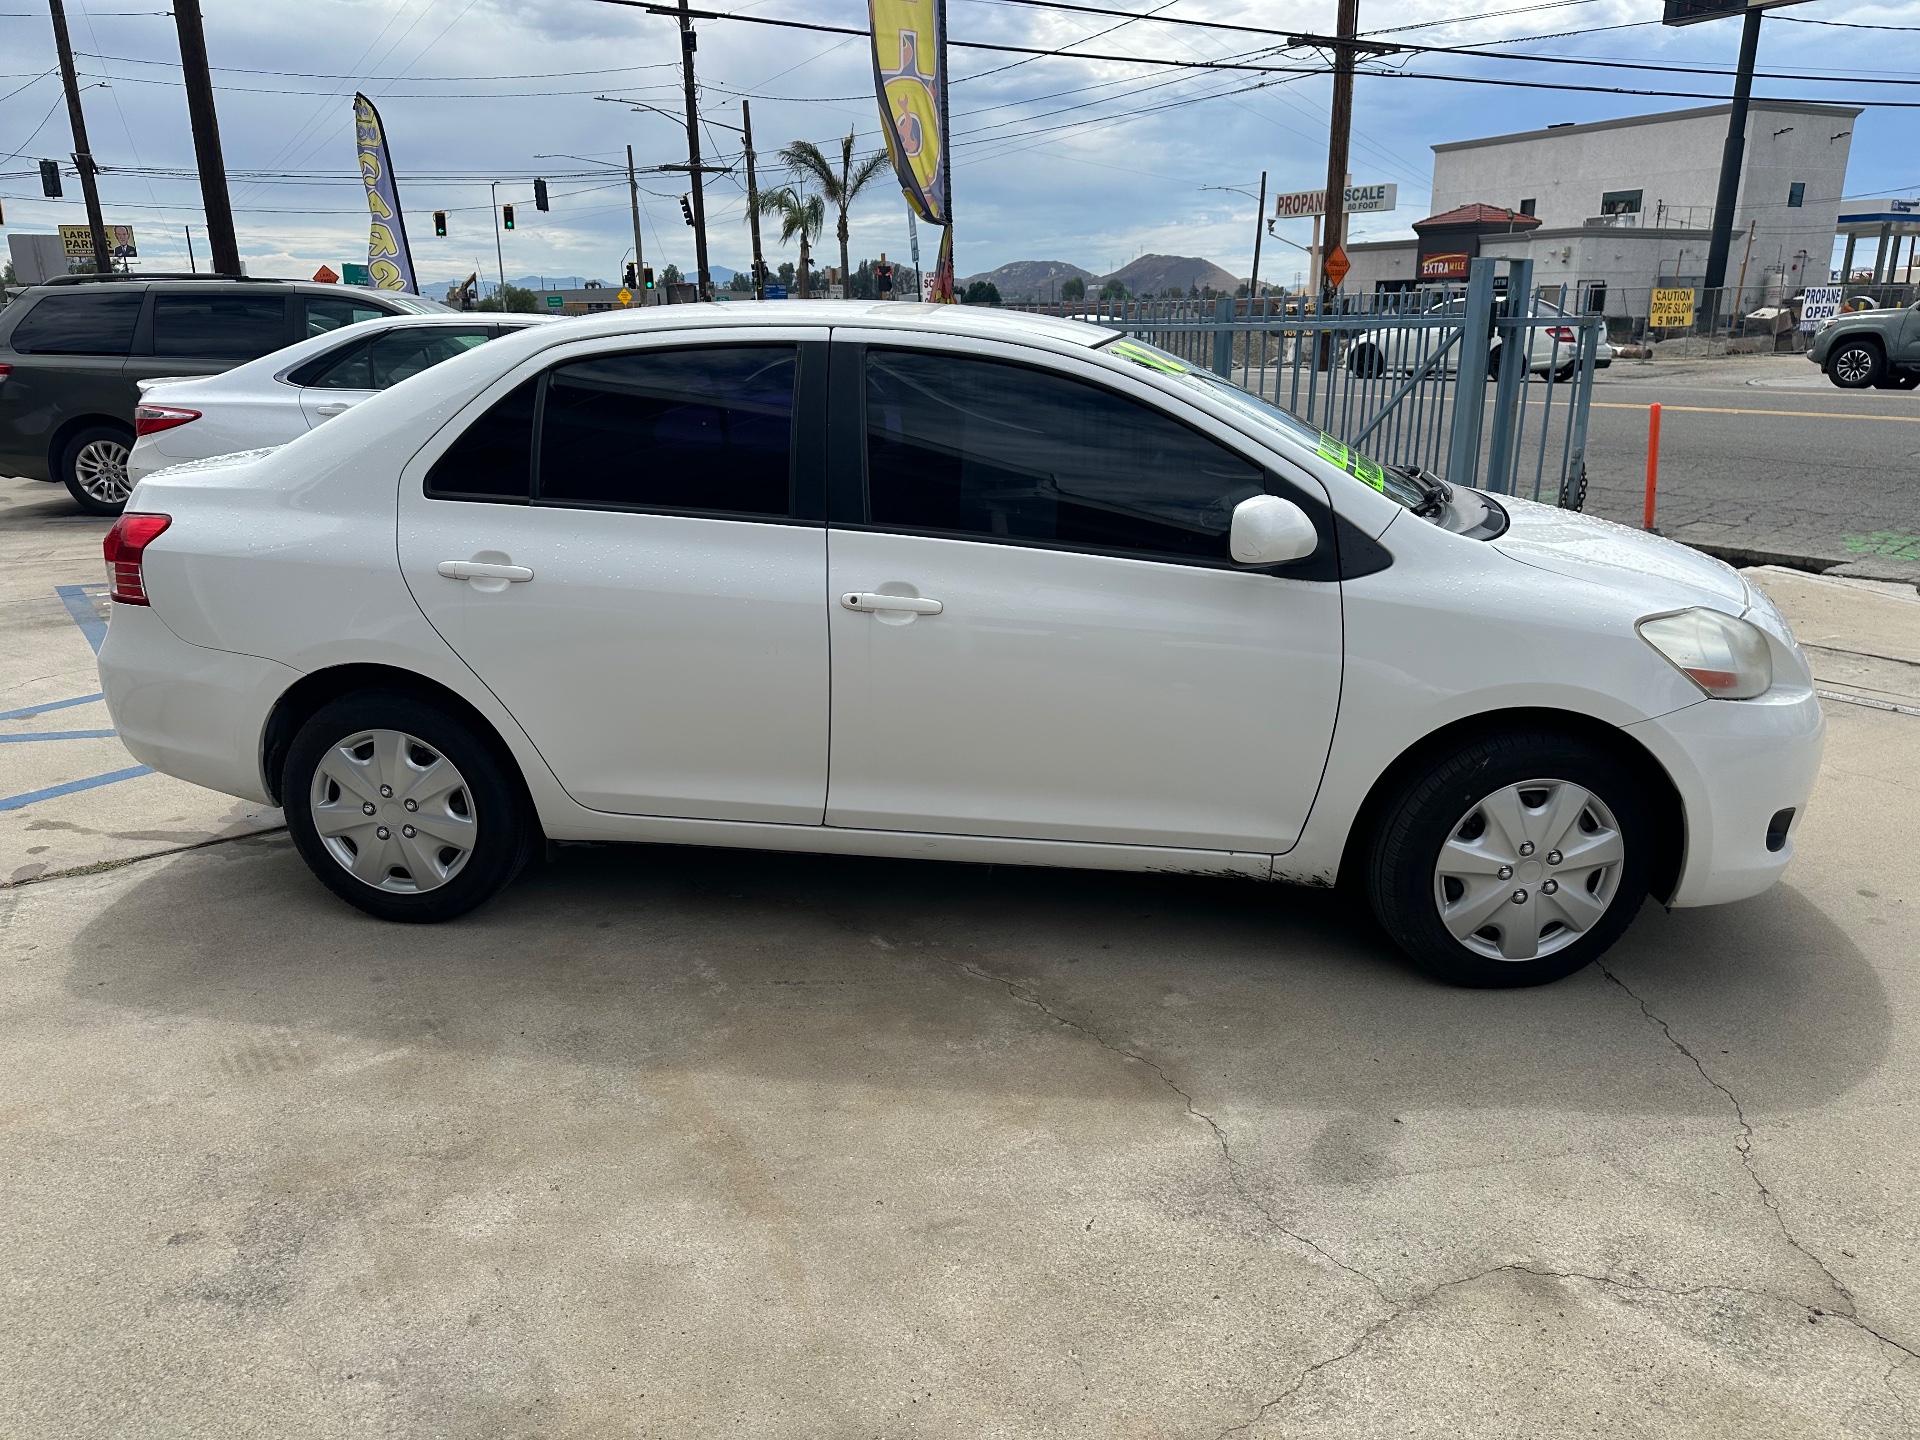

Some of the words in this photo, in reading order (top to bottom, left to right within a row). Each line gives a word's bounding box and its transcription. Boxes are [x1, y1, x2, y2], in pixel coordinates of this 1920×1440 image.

[1343, 186, 1385, 202] SCALE
[1277, 192, 1326, 215] PROPAN
[1358, 201, 1379, 210] FOOT
[63, 231, 91, 239] LARR
[65, 240, 112, 248] PARR
[1423, 262, 1449, 274] EXTRA
[1449, 261, 1465, 271] MILE
[1656, 290, 1692, 301] CAUTION
[1804, 289, 1841, 304] PROPANE
[1652, 302, 1673, 314] DRIVE
[1672, 302, 1693, 313] SLOW
[1805, 306, 1835, 319] OPEN
[1657, 316, 1663, 325] 5
[1665, 316, 1685, 325] MPH
